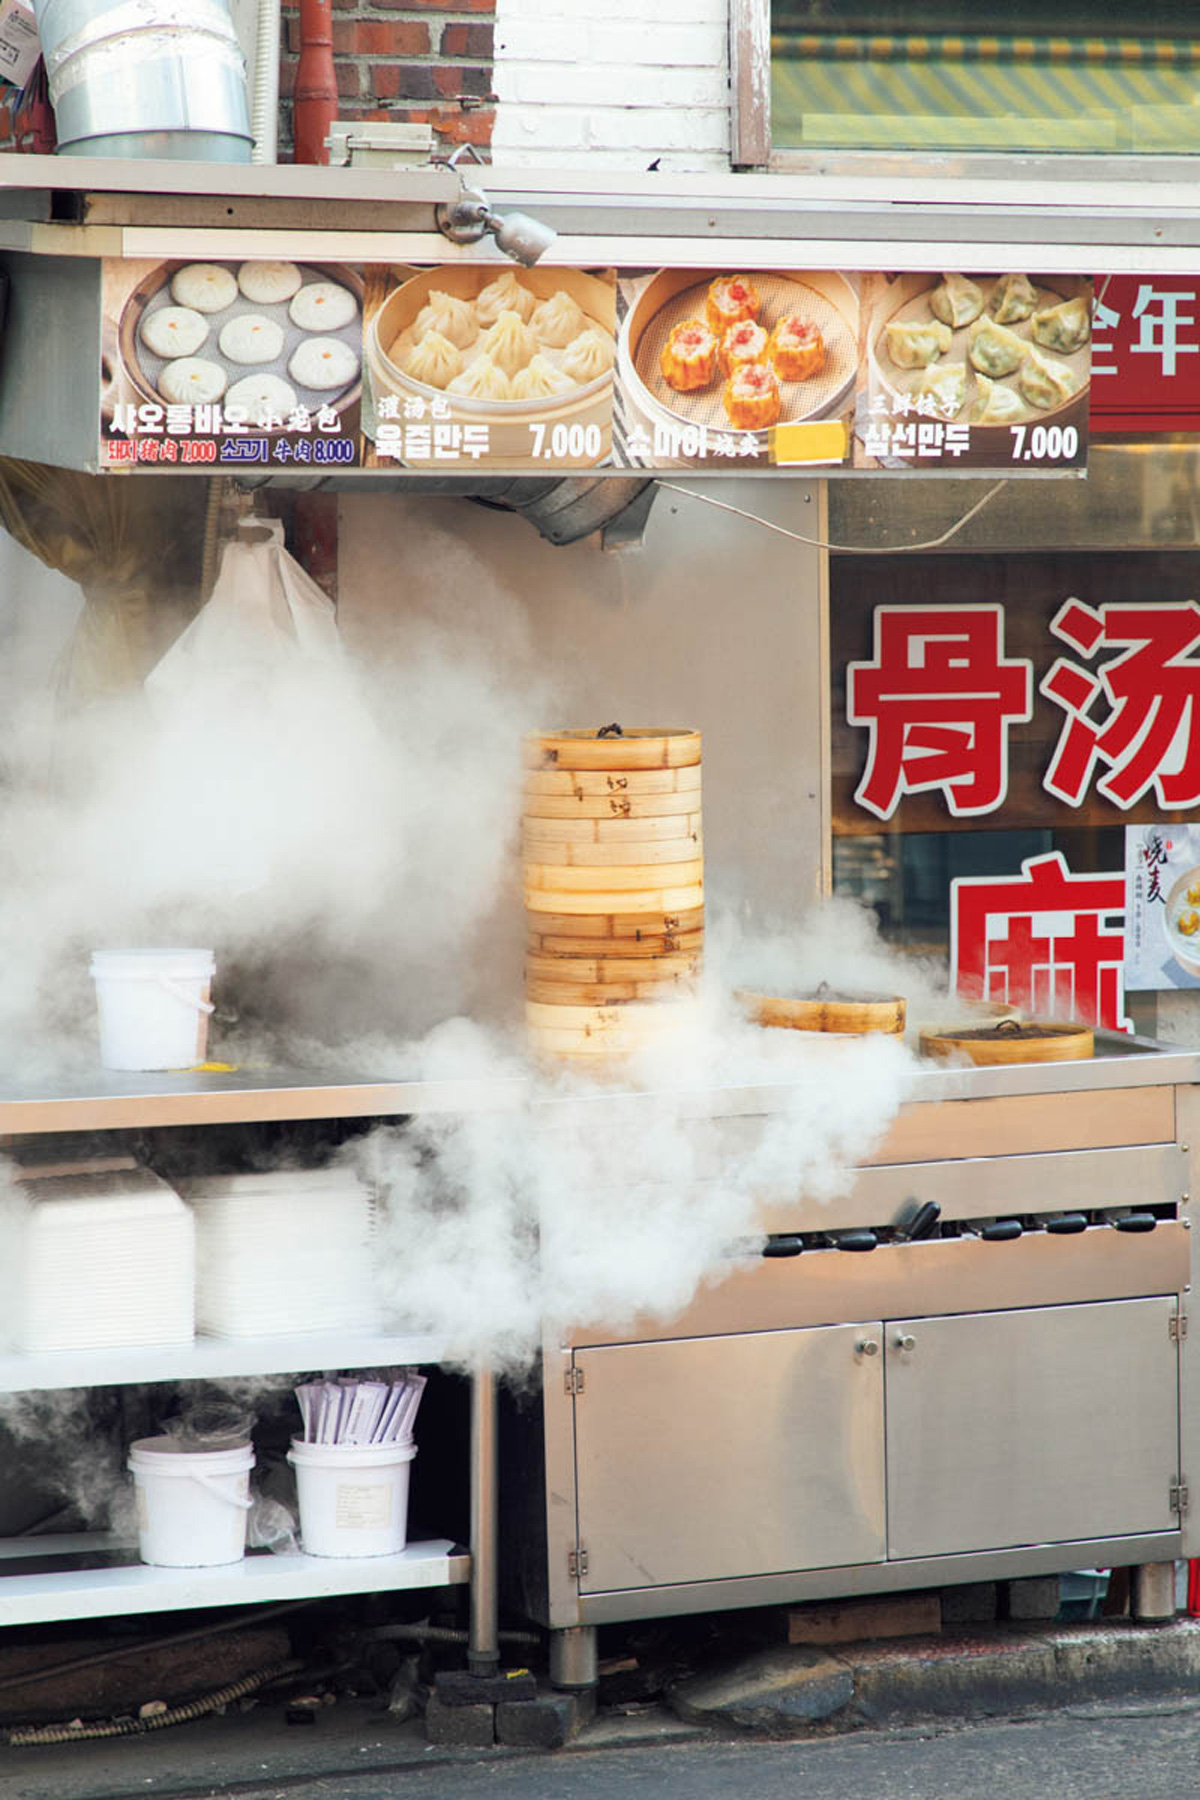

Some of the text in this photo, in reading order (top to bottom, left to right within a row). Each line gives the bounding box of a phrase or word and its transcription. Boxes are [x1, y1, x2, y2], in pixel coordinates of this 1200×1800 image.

[109, 404, 248, 435] 샤오롱바오
[220, 438, 269, 462] 소고기
[314, 440, 354, 462] 8,000
[375, 424, 602, 460] 육즙만두 7,000
[625, 424, 707, 458] 쇼마이
[865, 423, 1078, 460] 삼선만두 7,000
[846, 597, 1200, 820] 骨汤
